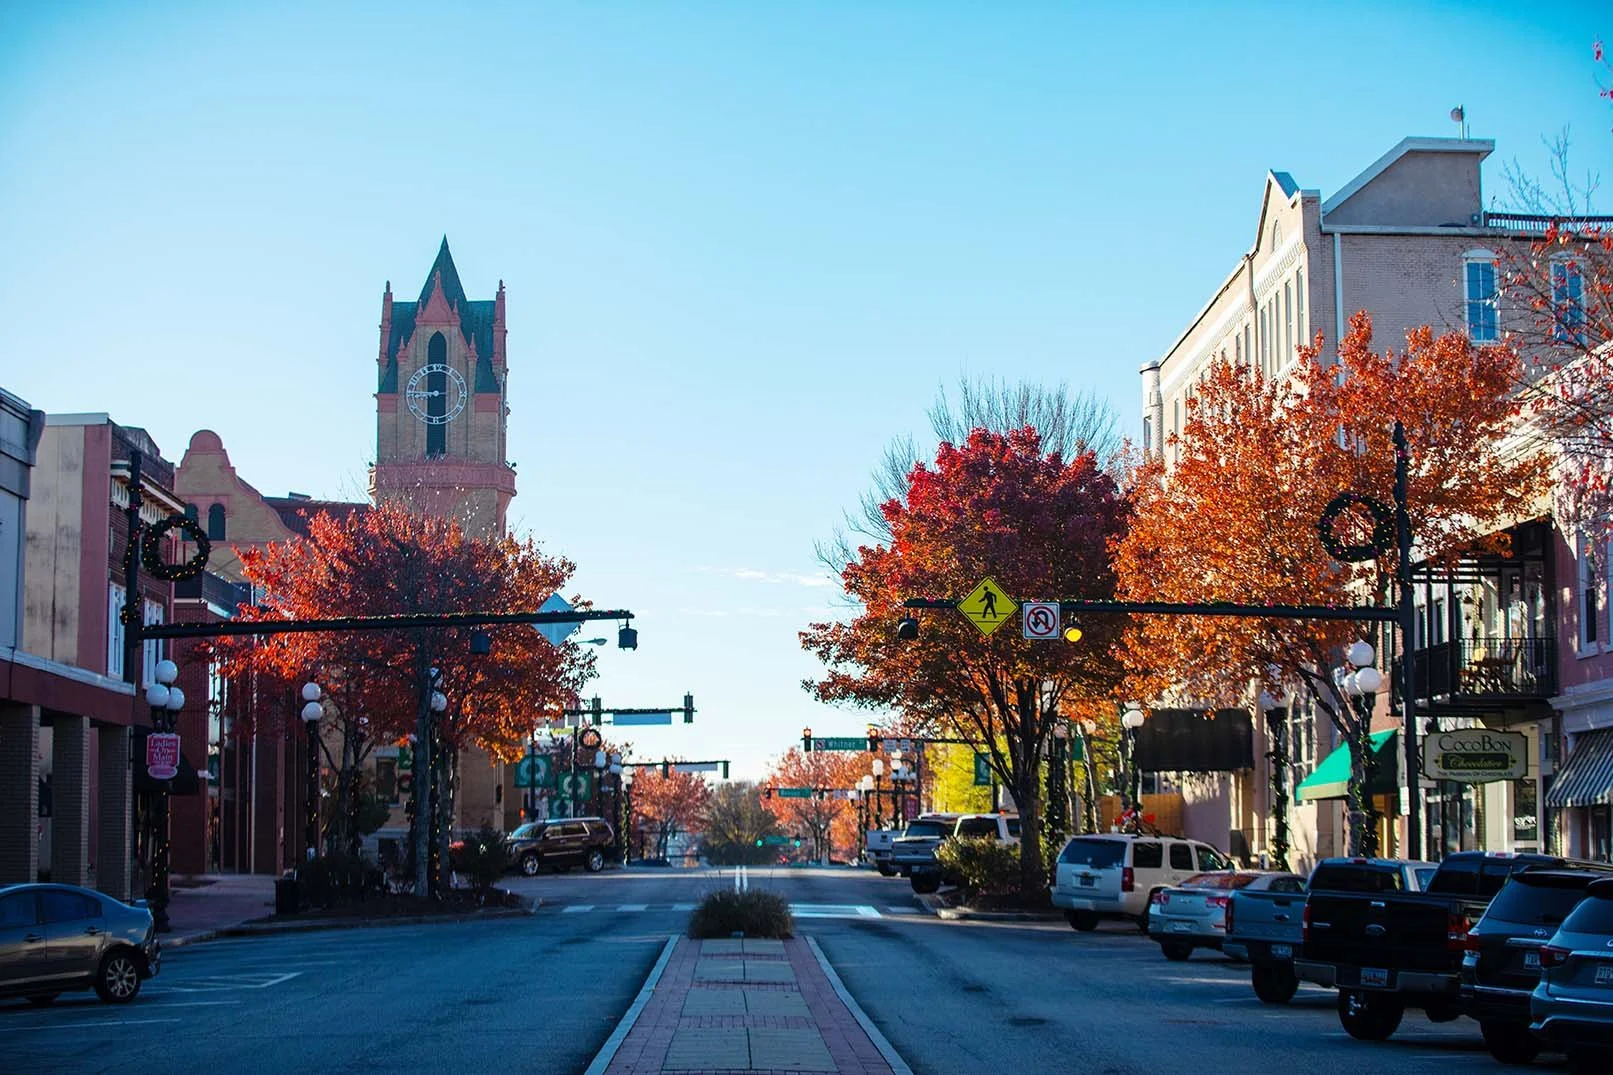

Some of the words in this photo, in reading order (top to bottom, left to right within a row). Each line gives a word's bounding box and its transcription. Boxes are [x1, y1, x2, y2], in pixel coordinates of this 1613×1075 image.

[151, 738, 176, 747] Ladies
[827, 739, 856, 749] Whitner
[153, 752, 173, 761] Main
